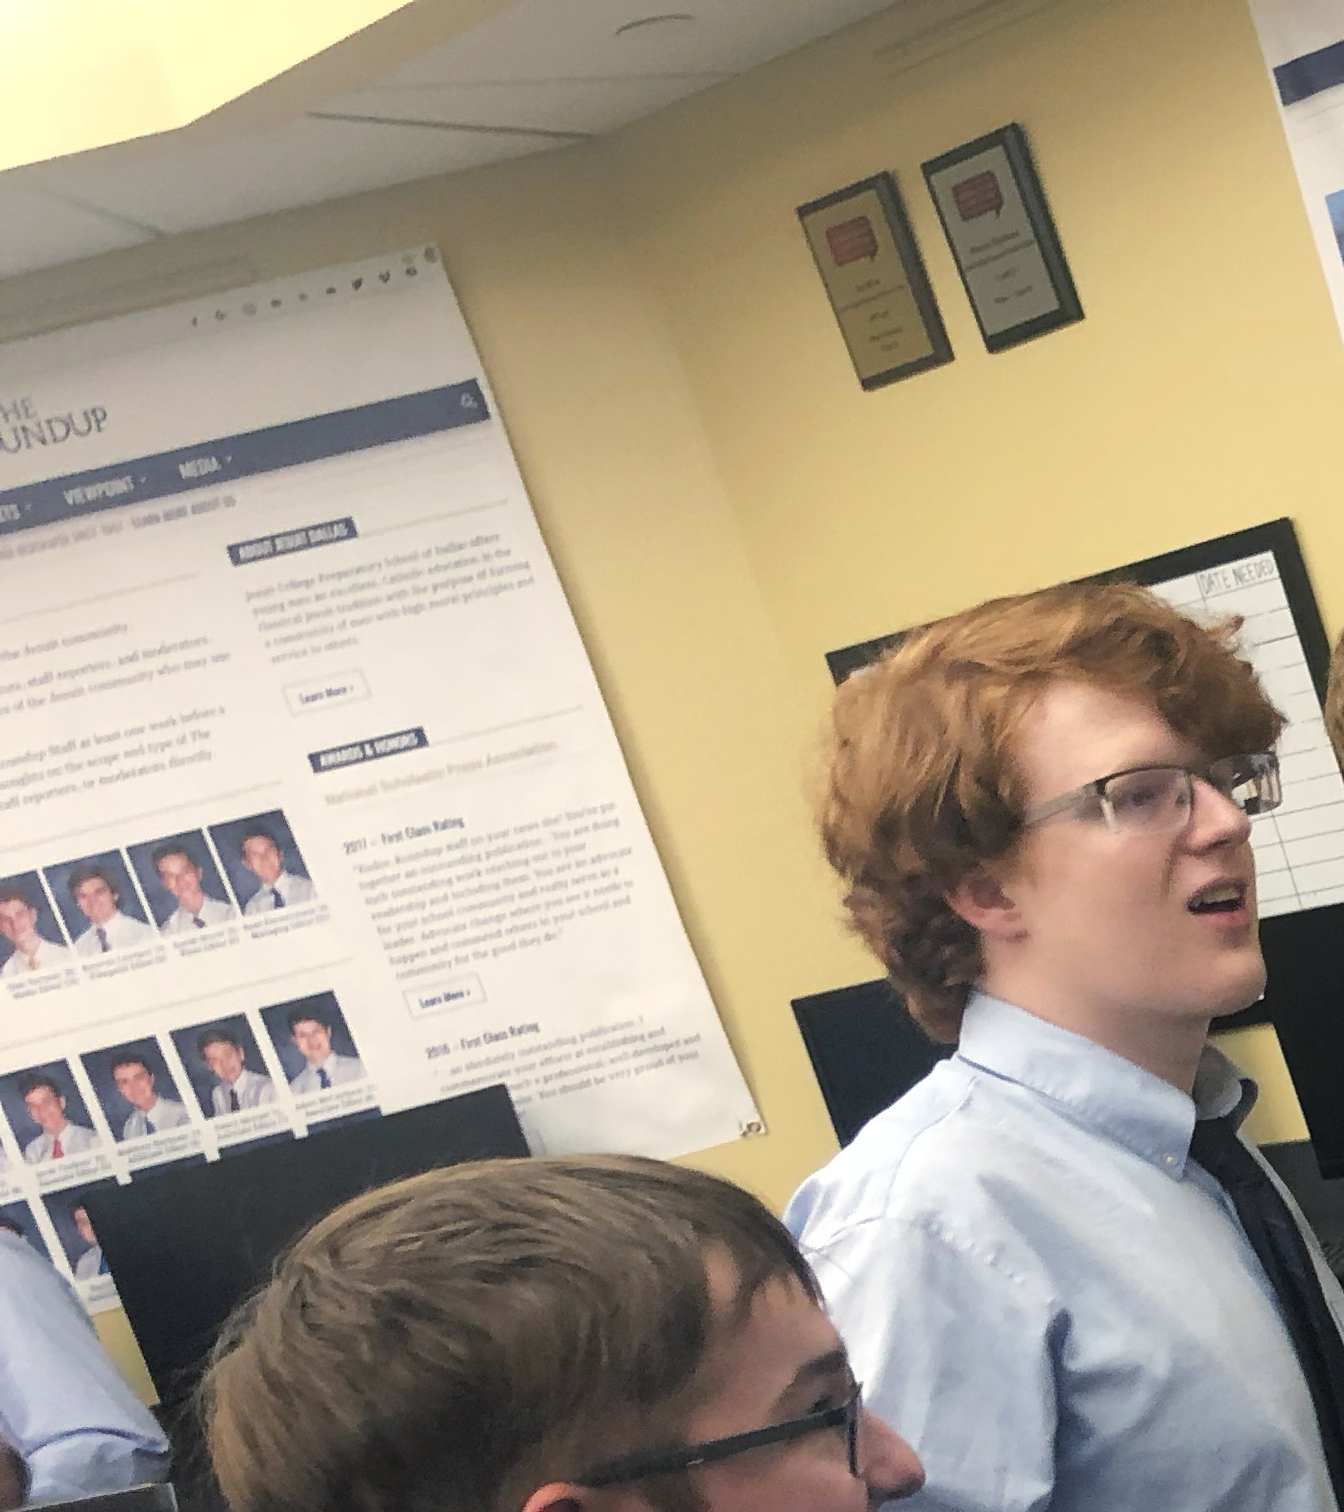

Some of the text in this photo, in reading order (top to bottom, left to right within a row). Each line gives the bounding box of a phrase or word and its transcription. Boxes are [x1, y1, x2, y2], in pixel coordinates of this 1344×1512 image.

[0, 406, 108, 453] UNDUP
[1199, 557, 1275, 594] DATE NEEDED
